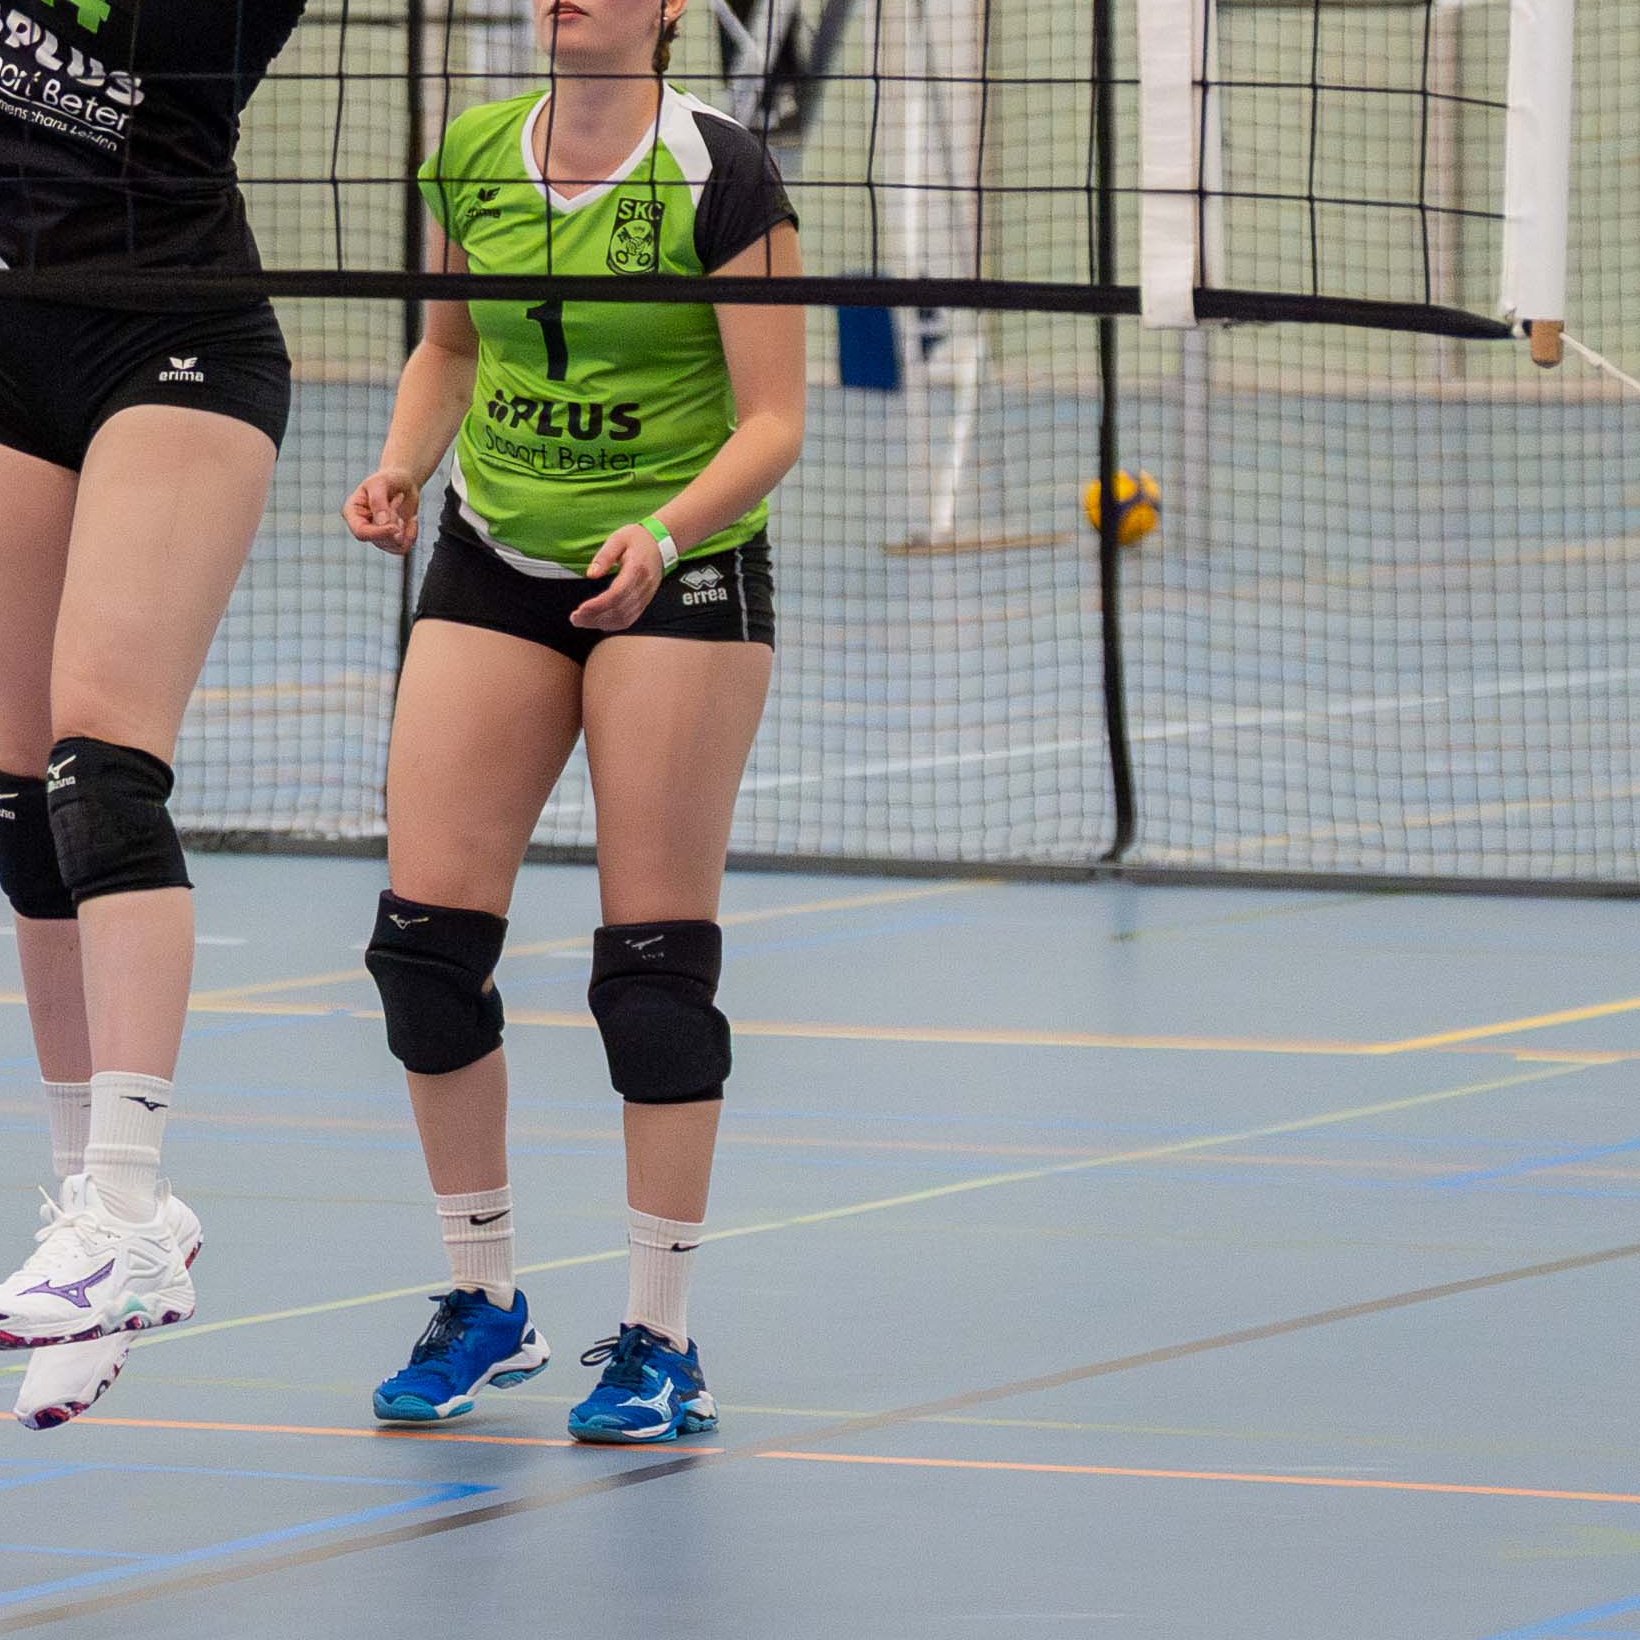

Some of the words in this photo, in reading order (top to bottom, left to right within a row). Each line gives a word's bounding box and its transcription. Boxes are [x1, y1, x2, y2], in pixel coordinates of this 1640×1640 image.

[4, 9, 145, 106] PLUS
[42, 78, 132, 131] Beter
[618, 199, 664, 221] SKC
[525, 296, 569, 382] 1
[159, 368, 205, 384] erima
[509, 395, 642, 442] PLUS
[558, 446, 642, 472] Beter
[682, 587, 728, 606] errea
